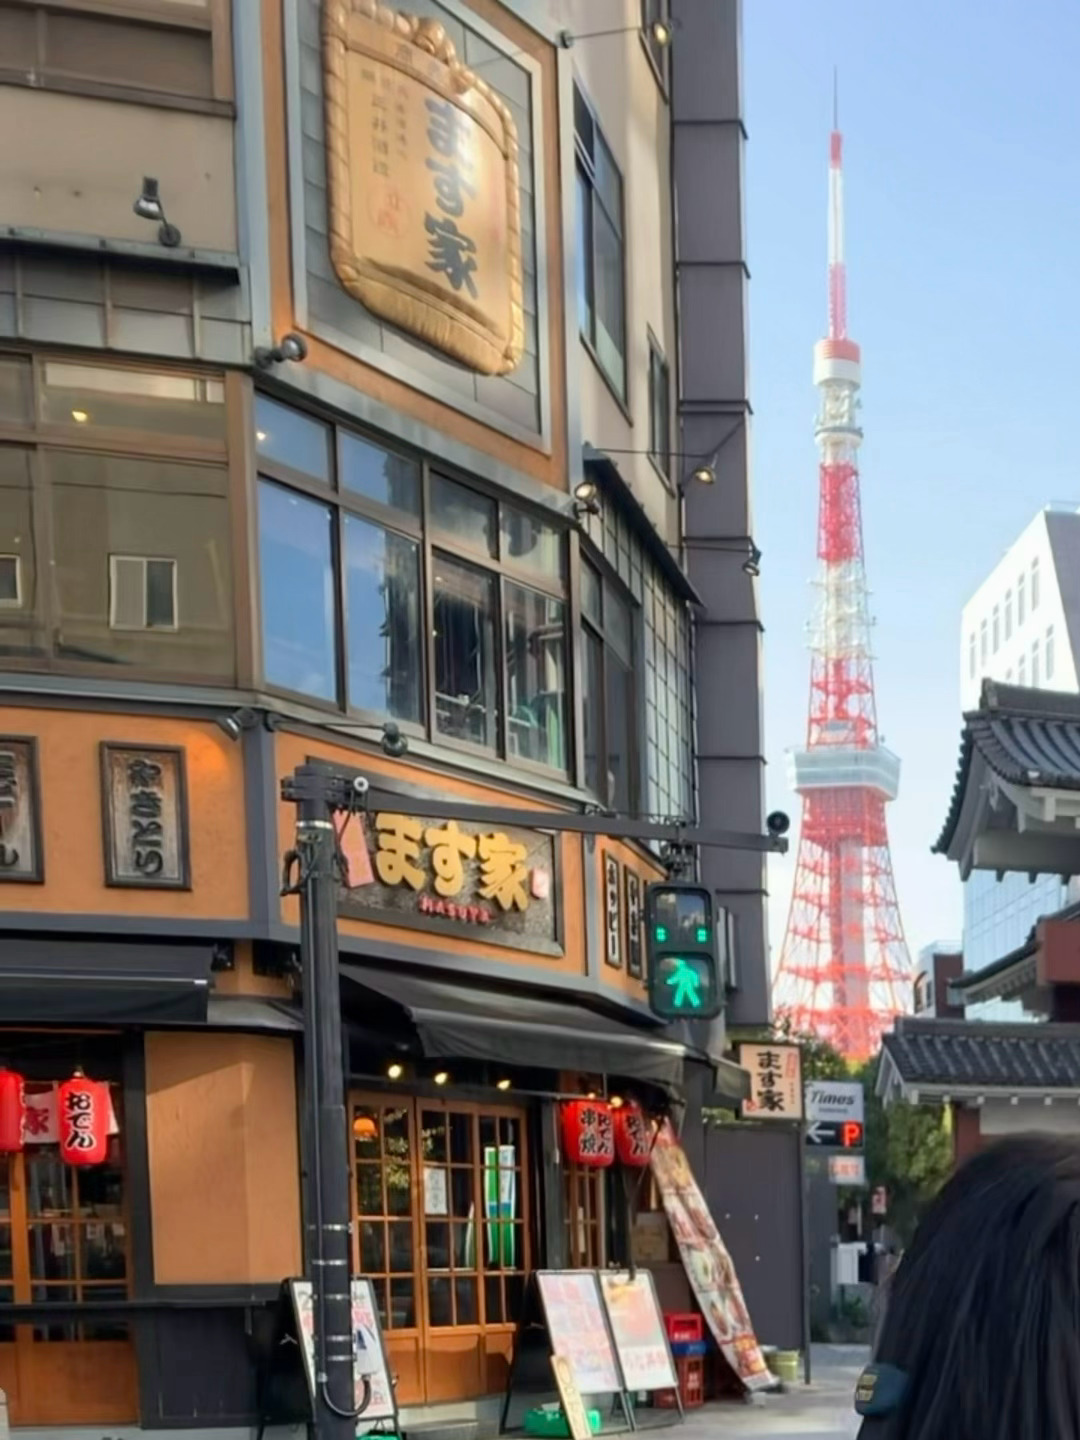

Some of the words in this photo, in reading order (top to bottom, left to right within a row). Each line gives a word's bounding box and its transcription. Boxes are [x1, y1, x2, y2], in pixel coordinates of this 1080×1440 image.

[375, 812, 528, 911] ます家
[420, 896, 491, 924] MASUYA
[756, 1051, 785, 1112] ます家
[811, 1090, 855, 1106] Times
[66, 1091, 94, 1149] おでん
[843, 1122, 861, 1147] P
